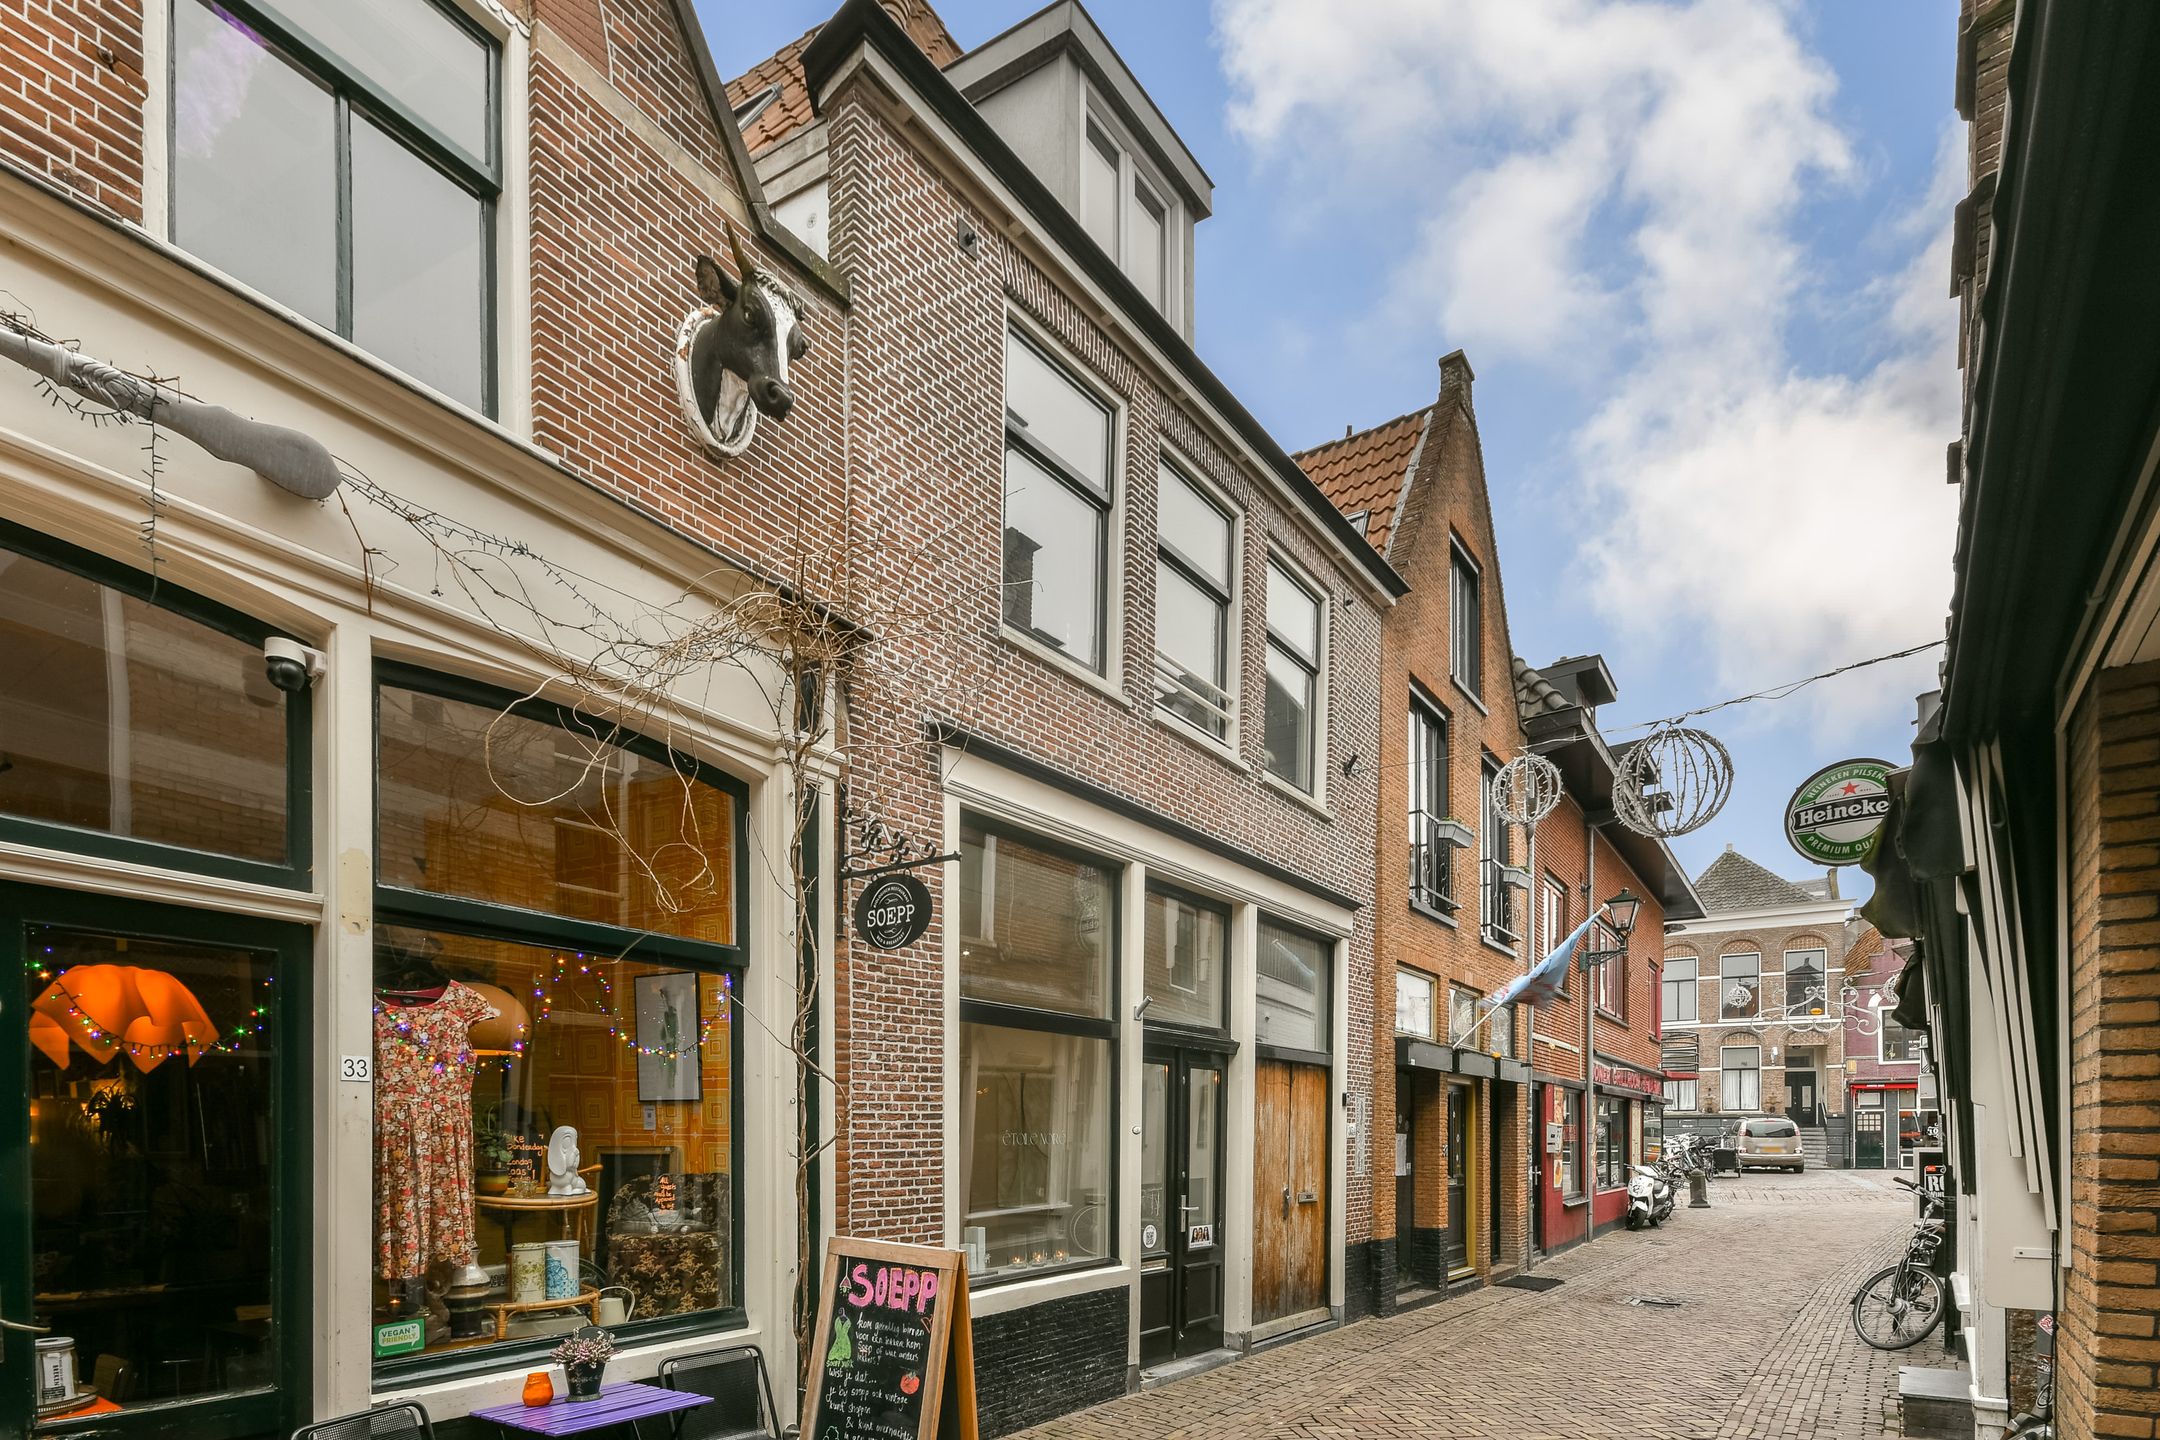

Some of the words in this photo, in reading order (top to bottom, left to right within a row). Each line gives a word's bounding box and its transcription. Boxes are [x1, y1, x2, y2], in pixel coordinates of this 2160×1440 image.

[1806, 771, 1849, 798] HEINEKEN
[1799, 799, 1889, 827] Heineke
[1806, 835, 1850, 855] PREMIUM
[867, 904, 915, 928] SOEPP
[344, 1058, 368, 1078] 33
[848, 1264, 939, 1313] SOEPP
[381, 1327, 411, 1338] VEGAN
[382, 1332, 417, 1344] FRIENDLY
